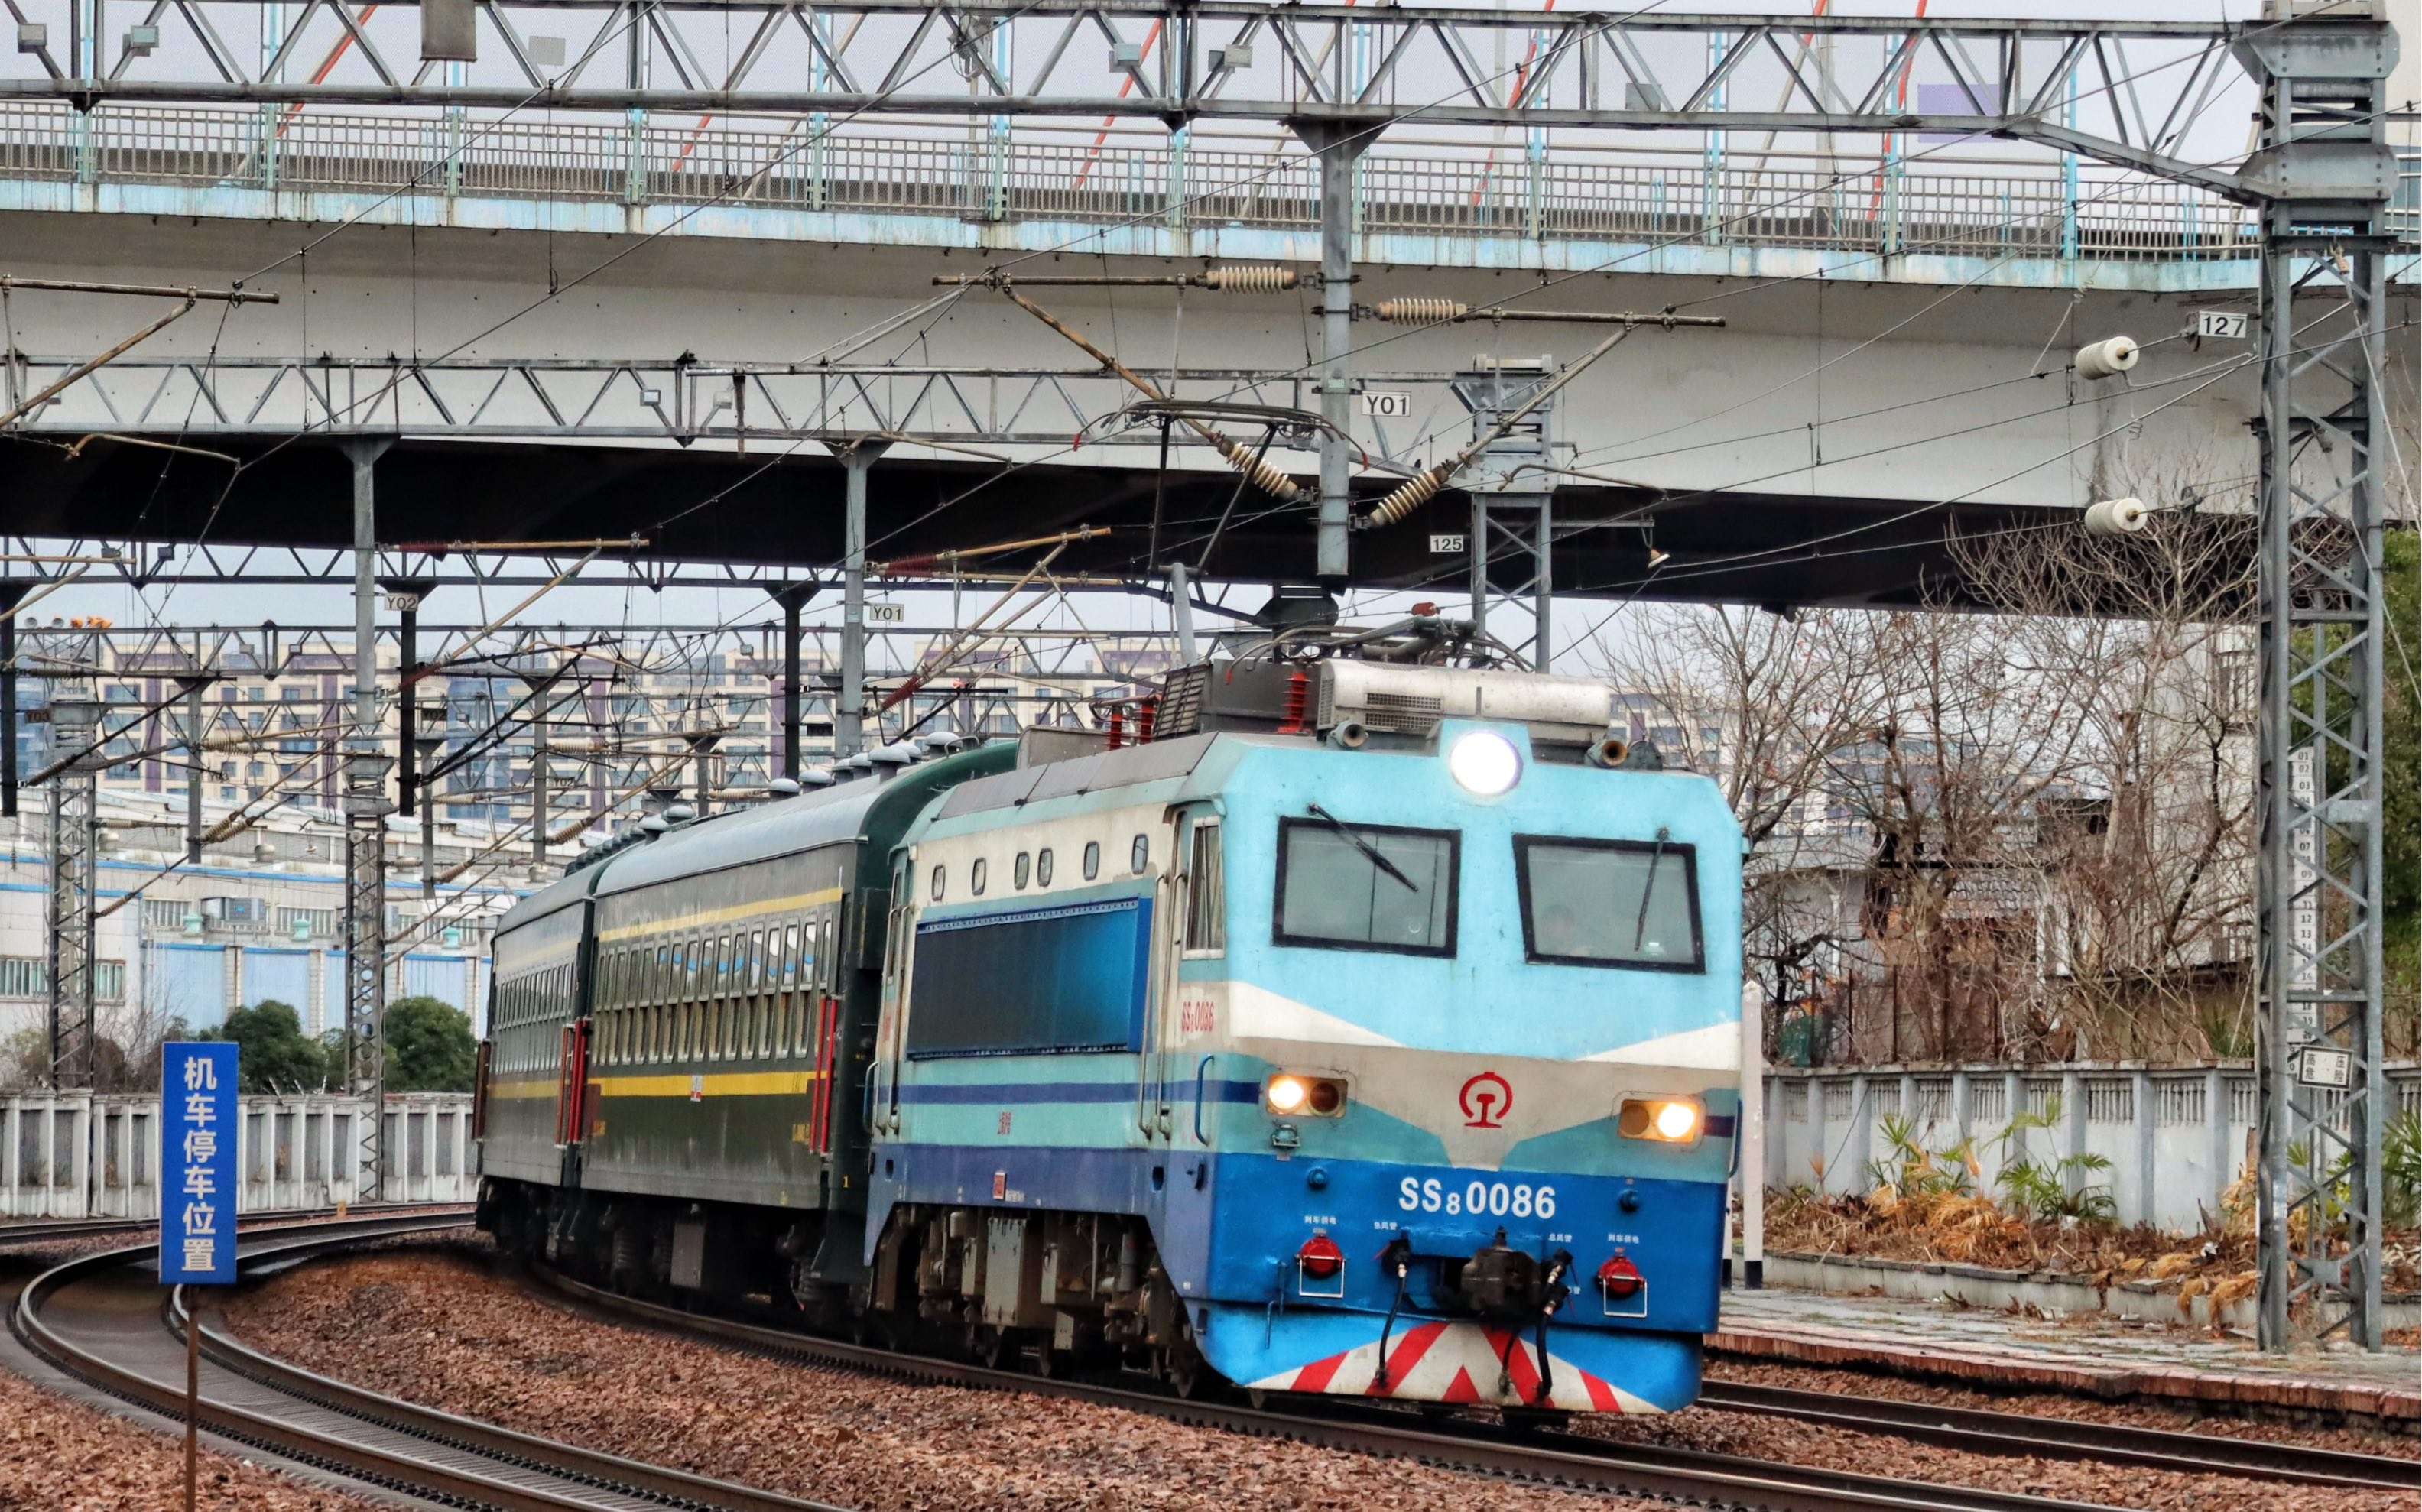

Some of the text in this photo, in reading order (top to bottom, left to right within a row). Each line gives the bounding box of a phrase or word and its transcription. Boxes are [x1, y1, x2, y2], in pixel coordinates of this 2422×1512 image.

[2203, 316, 2245, 336] 127
[1366, 395, 1407, 416] Y01
[1433, 537, 1463, 552] 125
[386, 596, 417, 610] Y02
[873, 606, 901, 621] Y01
[2298, 751, 2309, 761] 01
[2299, 764, 2310, 773] 02
[2299, 780, 2310, 790] 03
[2299, 842, 2310, 851] 07
[2301, 870, 2312, 878] 09
[2301, 915, 2312, 923] 12
[2301, 930, 2312, 939] 13
[181, 1056, 217, 1272] 机车停车位置
